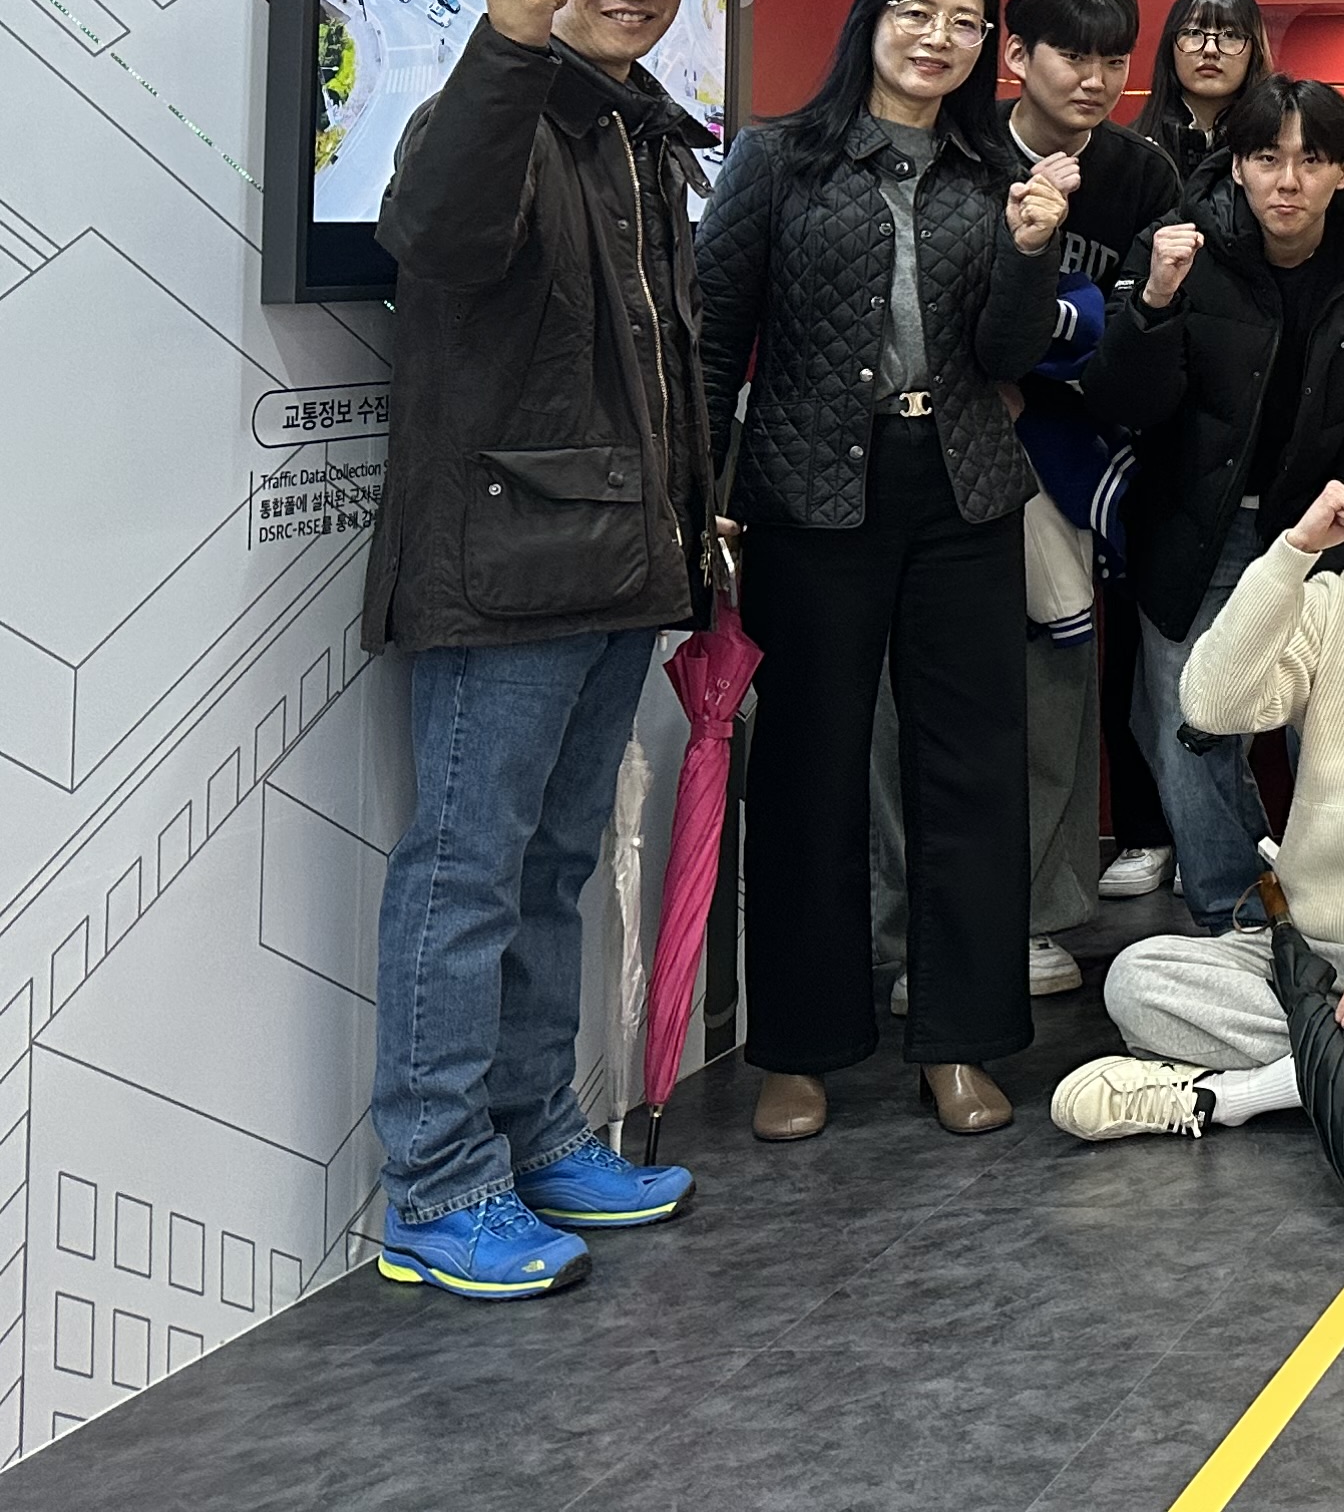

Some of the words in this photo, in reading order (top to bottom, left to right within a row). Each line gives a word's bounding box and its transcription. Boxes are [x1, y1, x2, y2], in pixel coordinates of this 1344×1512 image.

[282, 399, 352, 431] 교통정보
[357, 394, 389, 425] 수집
[260, 471, 297, 490] Traffic
[300, 469, 326, 485] Data
[329, 462, 381, 481] Collection
